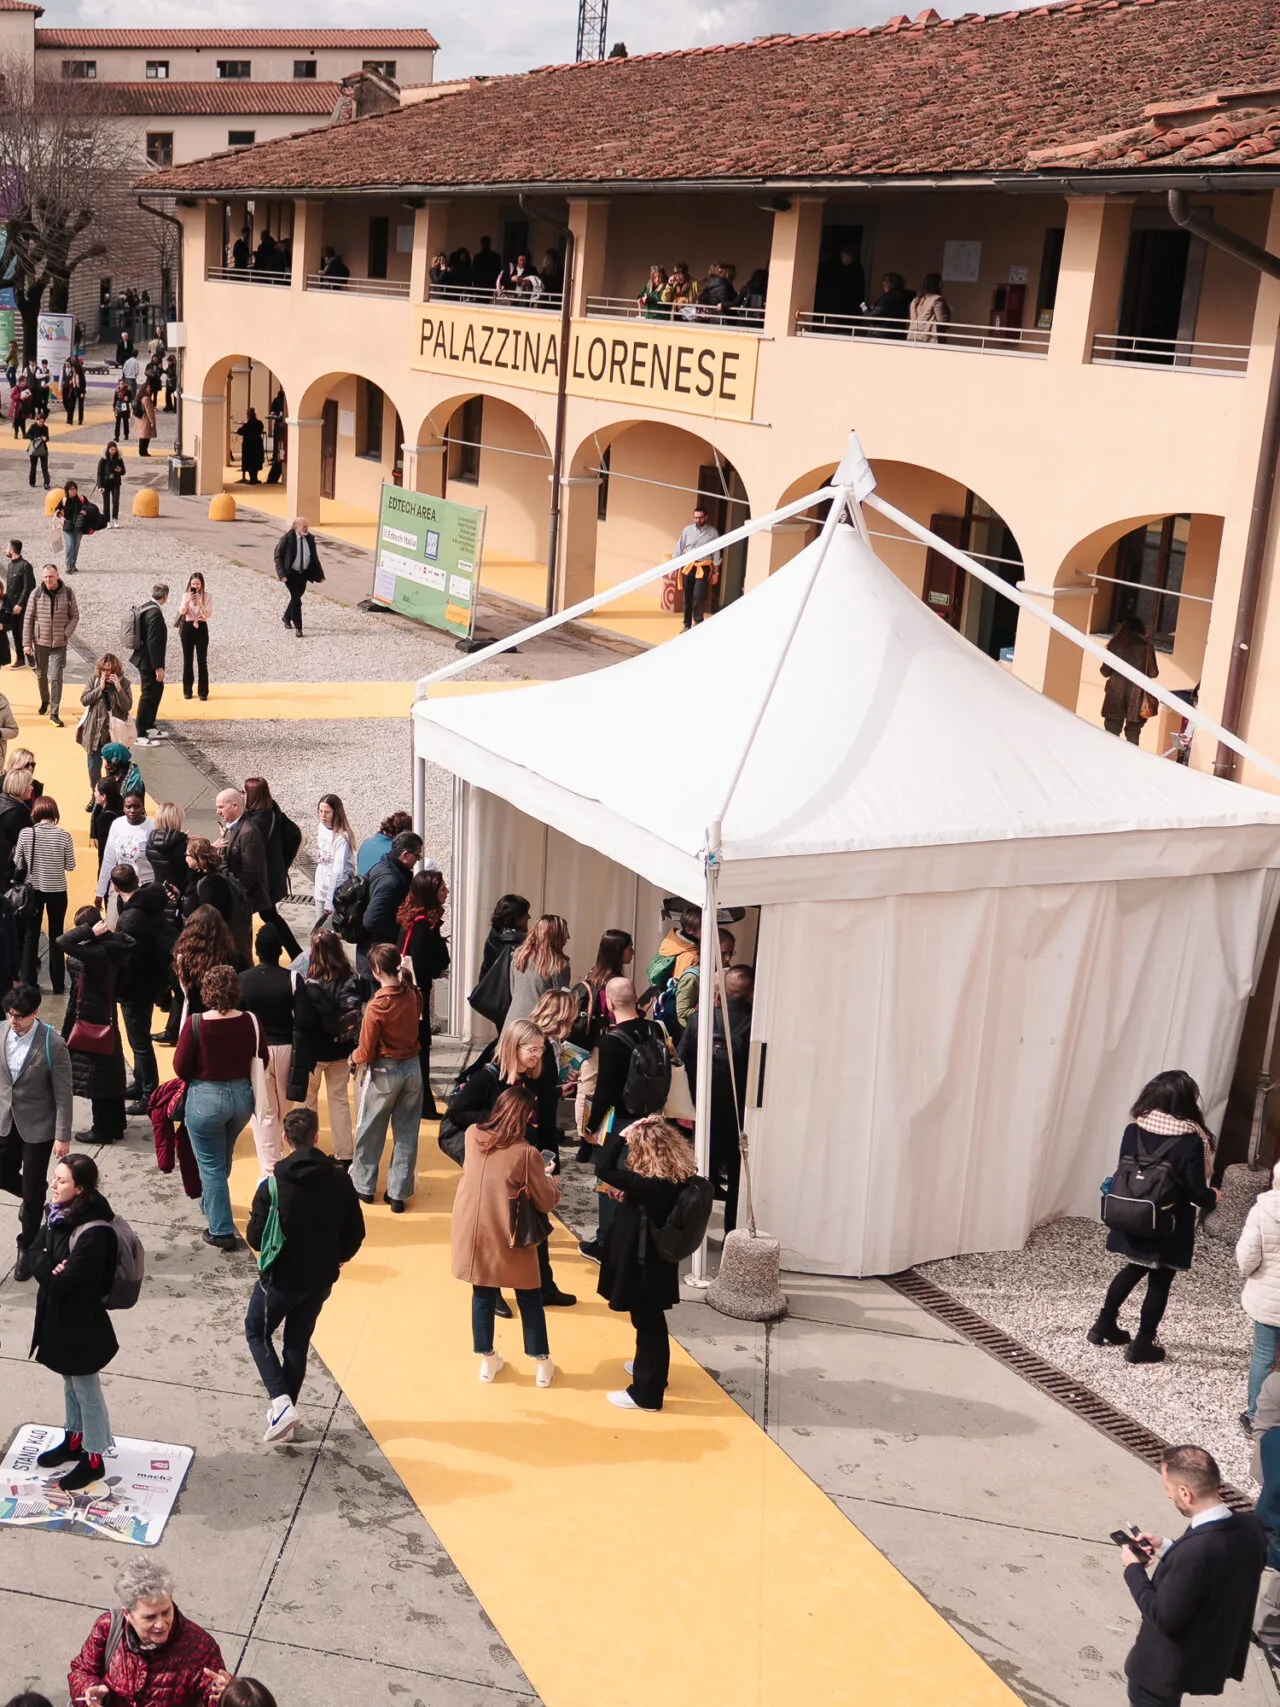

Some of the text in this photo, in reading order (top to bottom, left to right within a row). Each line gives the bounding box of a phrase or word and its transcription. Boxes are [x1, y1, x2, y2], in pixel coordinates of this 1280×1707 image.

[419, 317, 740, 401] PALAZZINA LORENESE
[388, 496, 436, 522] EDTECH AREA
[12, 1429, 49, 1472] STAND K40
[137, 1472, 173, 1482] mach2
